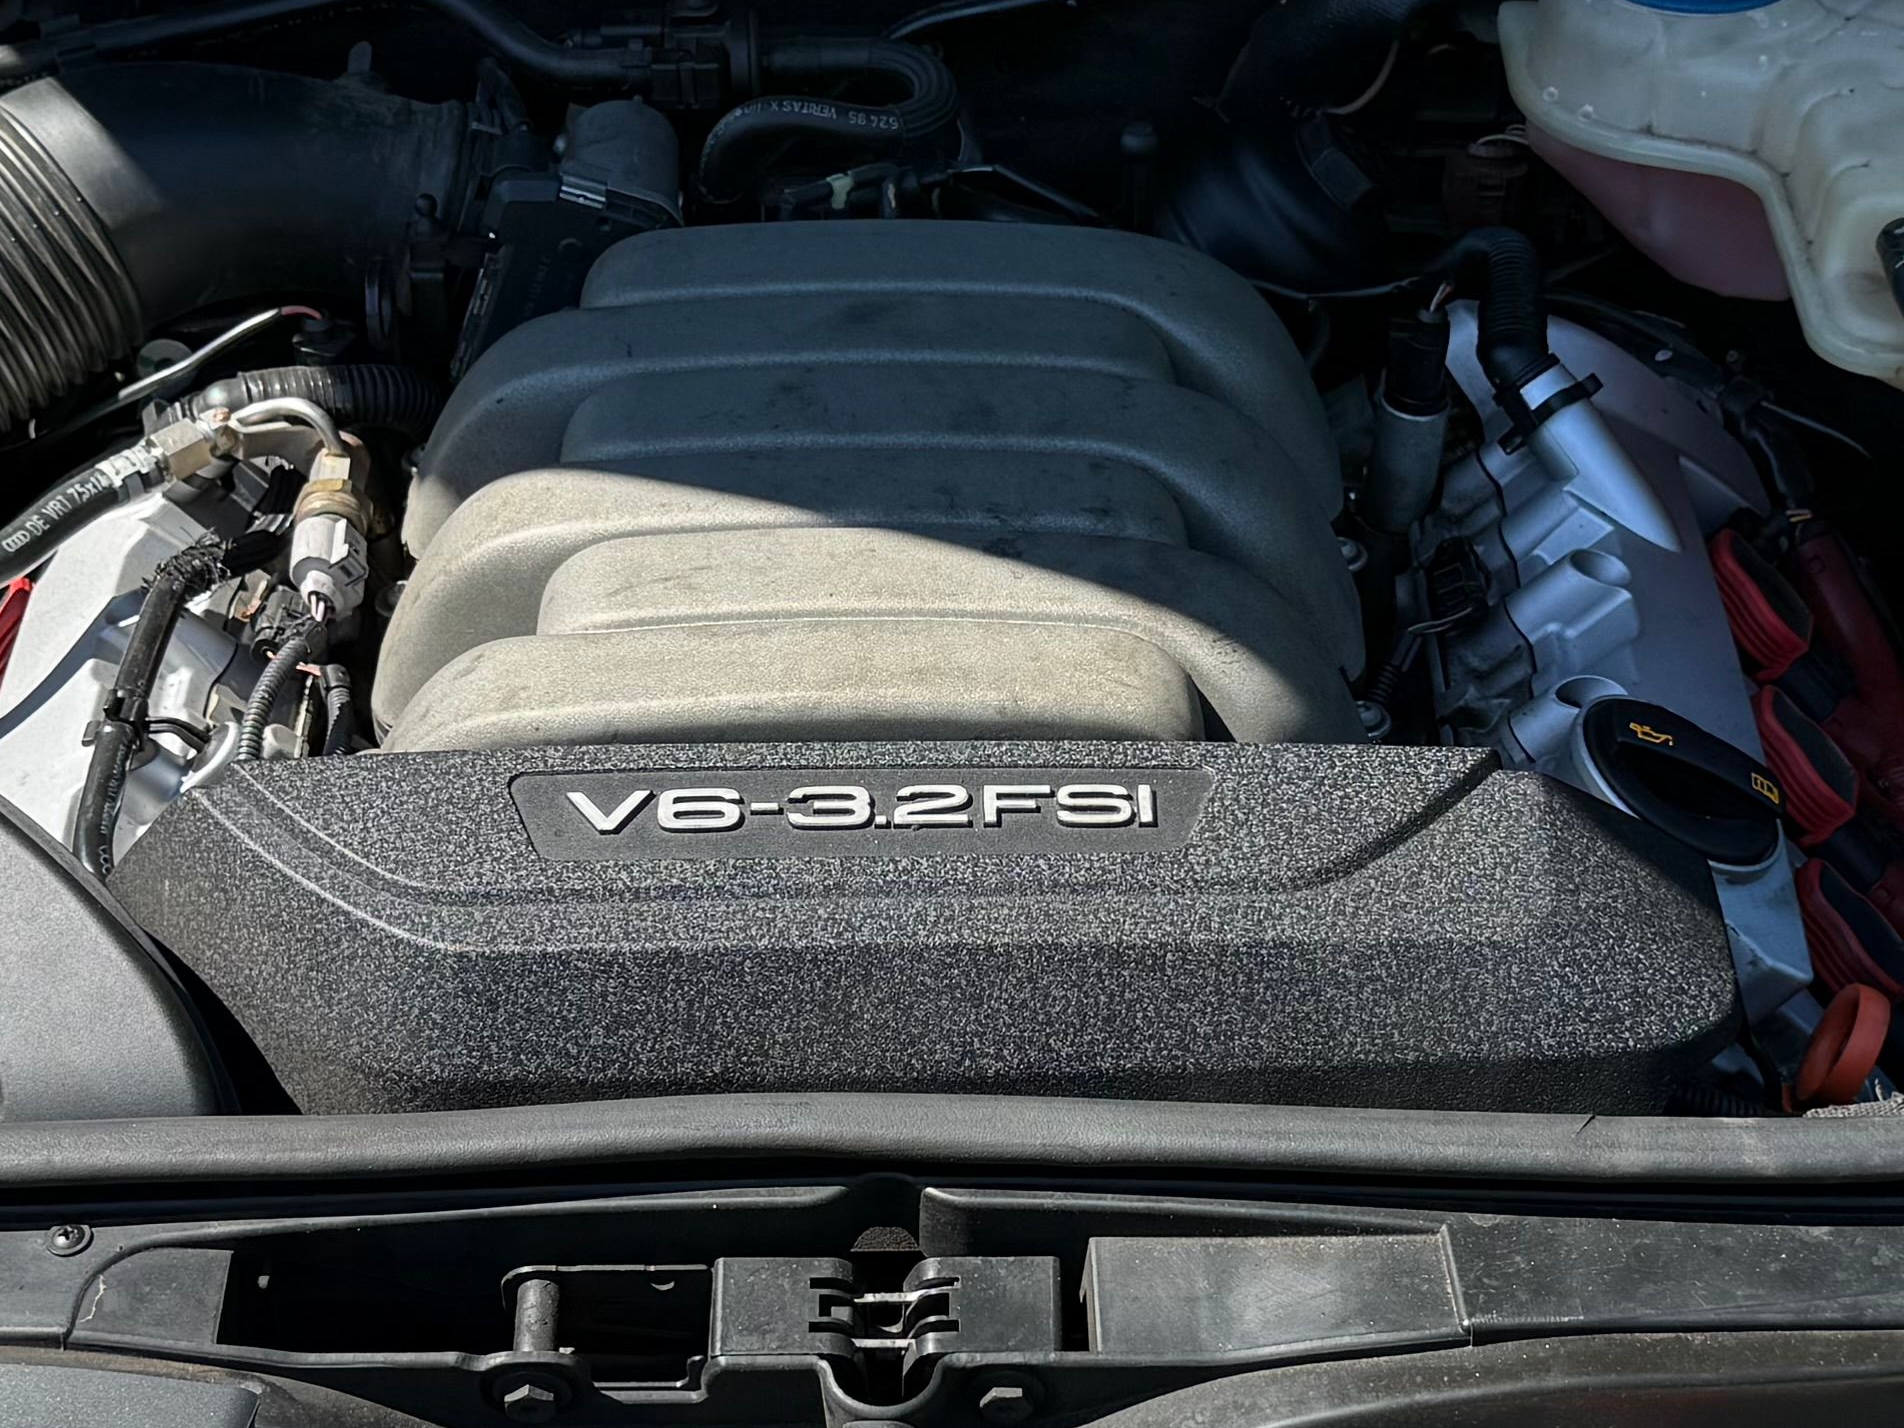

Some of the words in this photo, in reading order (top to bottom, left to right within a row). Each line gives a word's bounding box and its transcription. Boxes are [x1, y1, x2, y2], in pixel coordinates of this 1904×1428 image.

[782, 100, 837, 119] VERITAS
[26, 515, 51, 537] OE
[42, 494, 73, 521] VRT
[564, 782, 1156, 836] V6-3.2FSI
